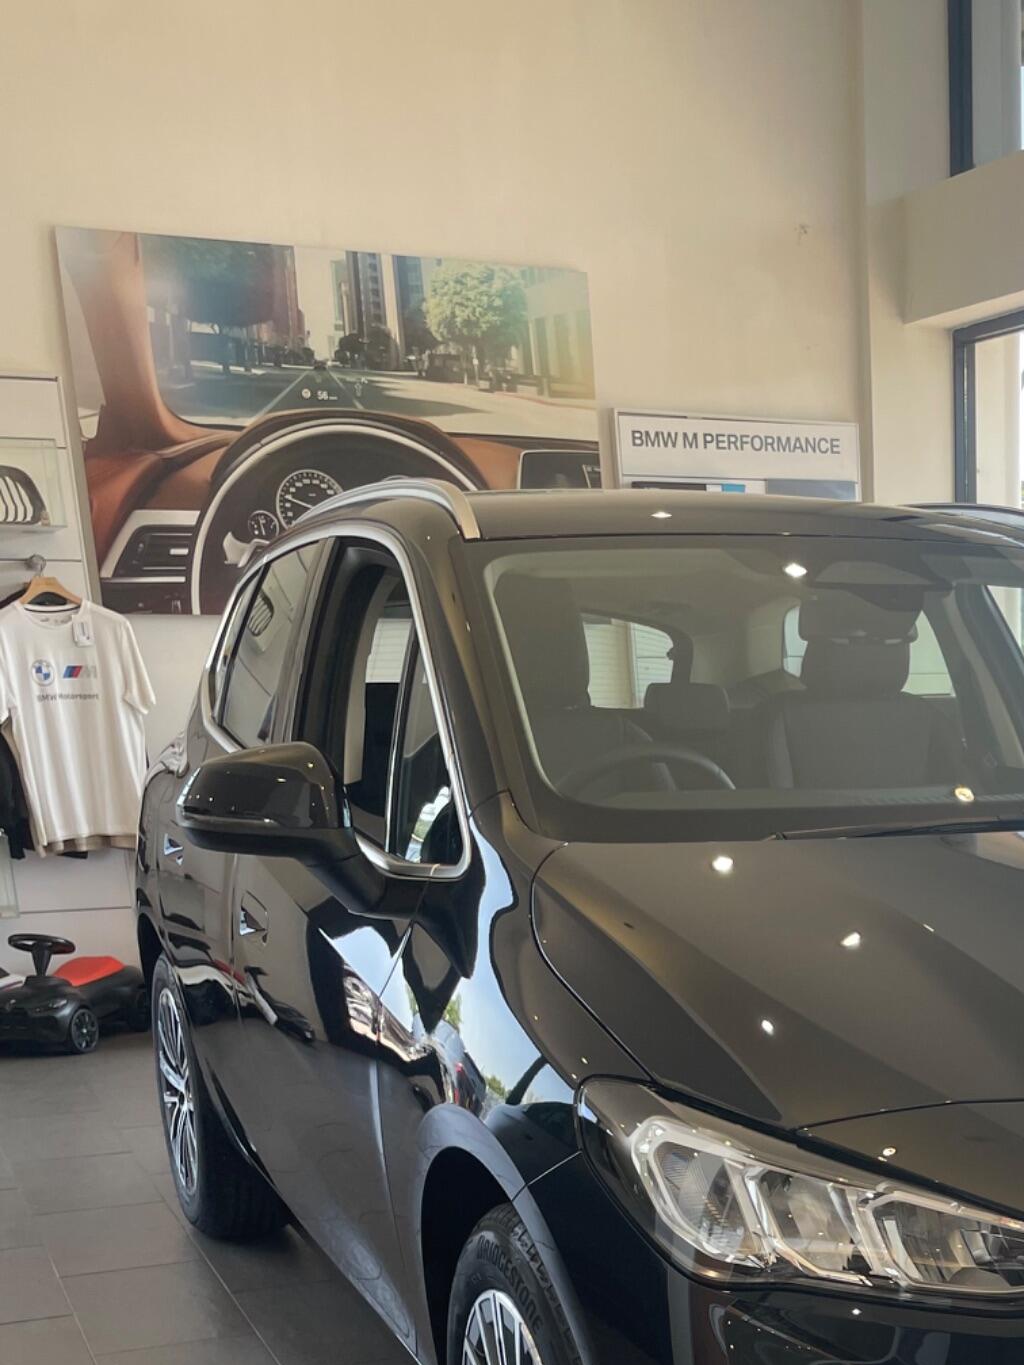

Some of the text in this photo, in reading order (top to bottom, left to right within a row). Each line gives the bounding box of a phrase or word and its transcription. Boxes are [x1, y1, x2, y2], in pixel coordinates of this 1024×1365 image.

[631, 430, 841, 455] BMW M PERFORMANCE
[477, 1235, 544, 1335] BRIDGESTONE
